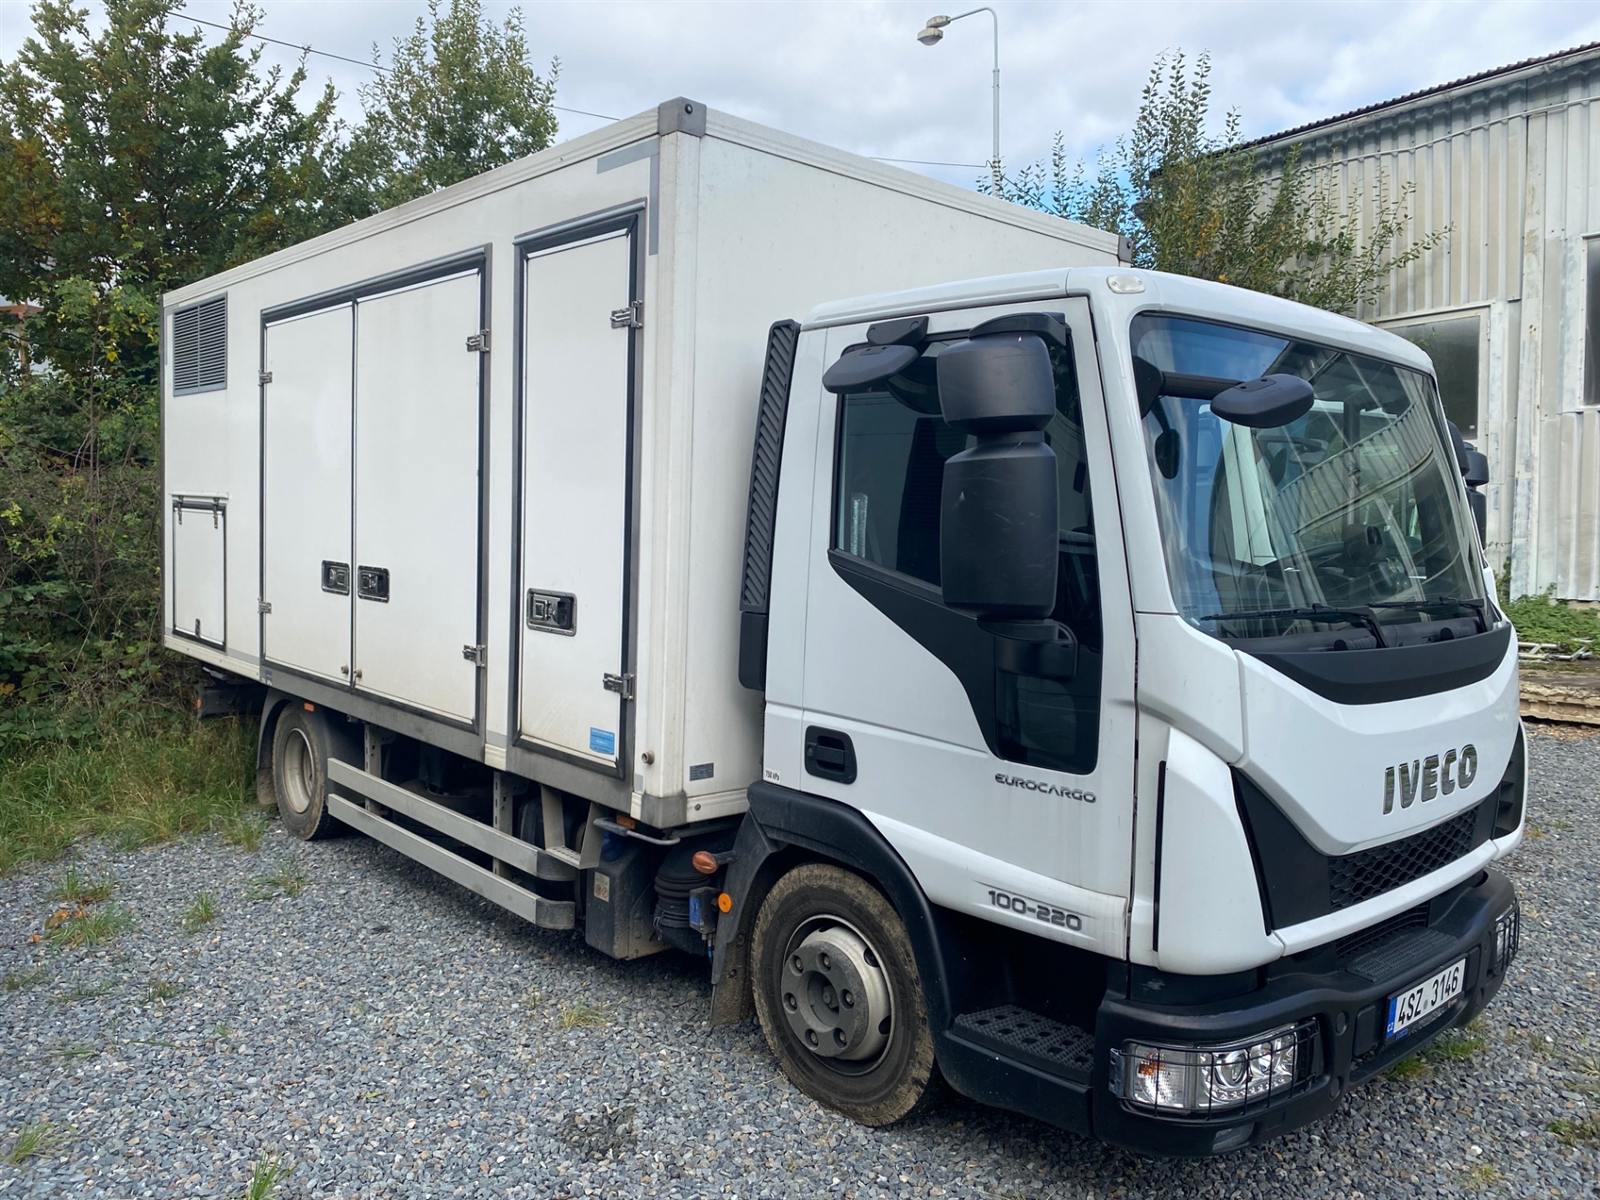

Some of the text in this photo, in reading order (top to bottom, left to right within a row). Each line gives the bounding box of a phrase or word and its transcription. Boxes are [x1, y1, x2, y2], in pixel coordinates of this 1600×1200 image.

[994, 773, 1097, 804] EUROCARGO
[1382, 743, 1478, 815] IVECO
[988, 889, 1083, 932] 100-220
[1398, 987, 1424, 1025] 4SZ
[1430, 966, 1460, 1007] 3146
